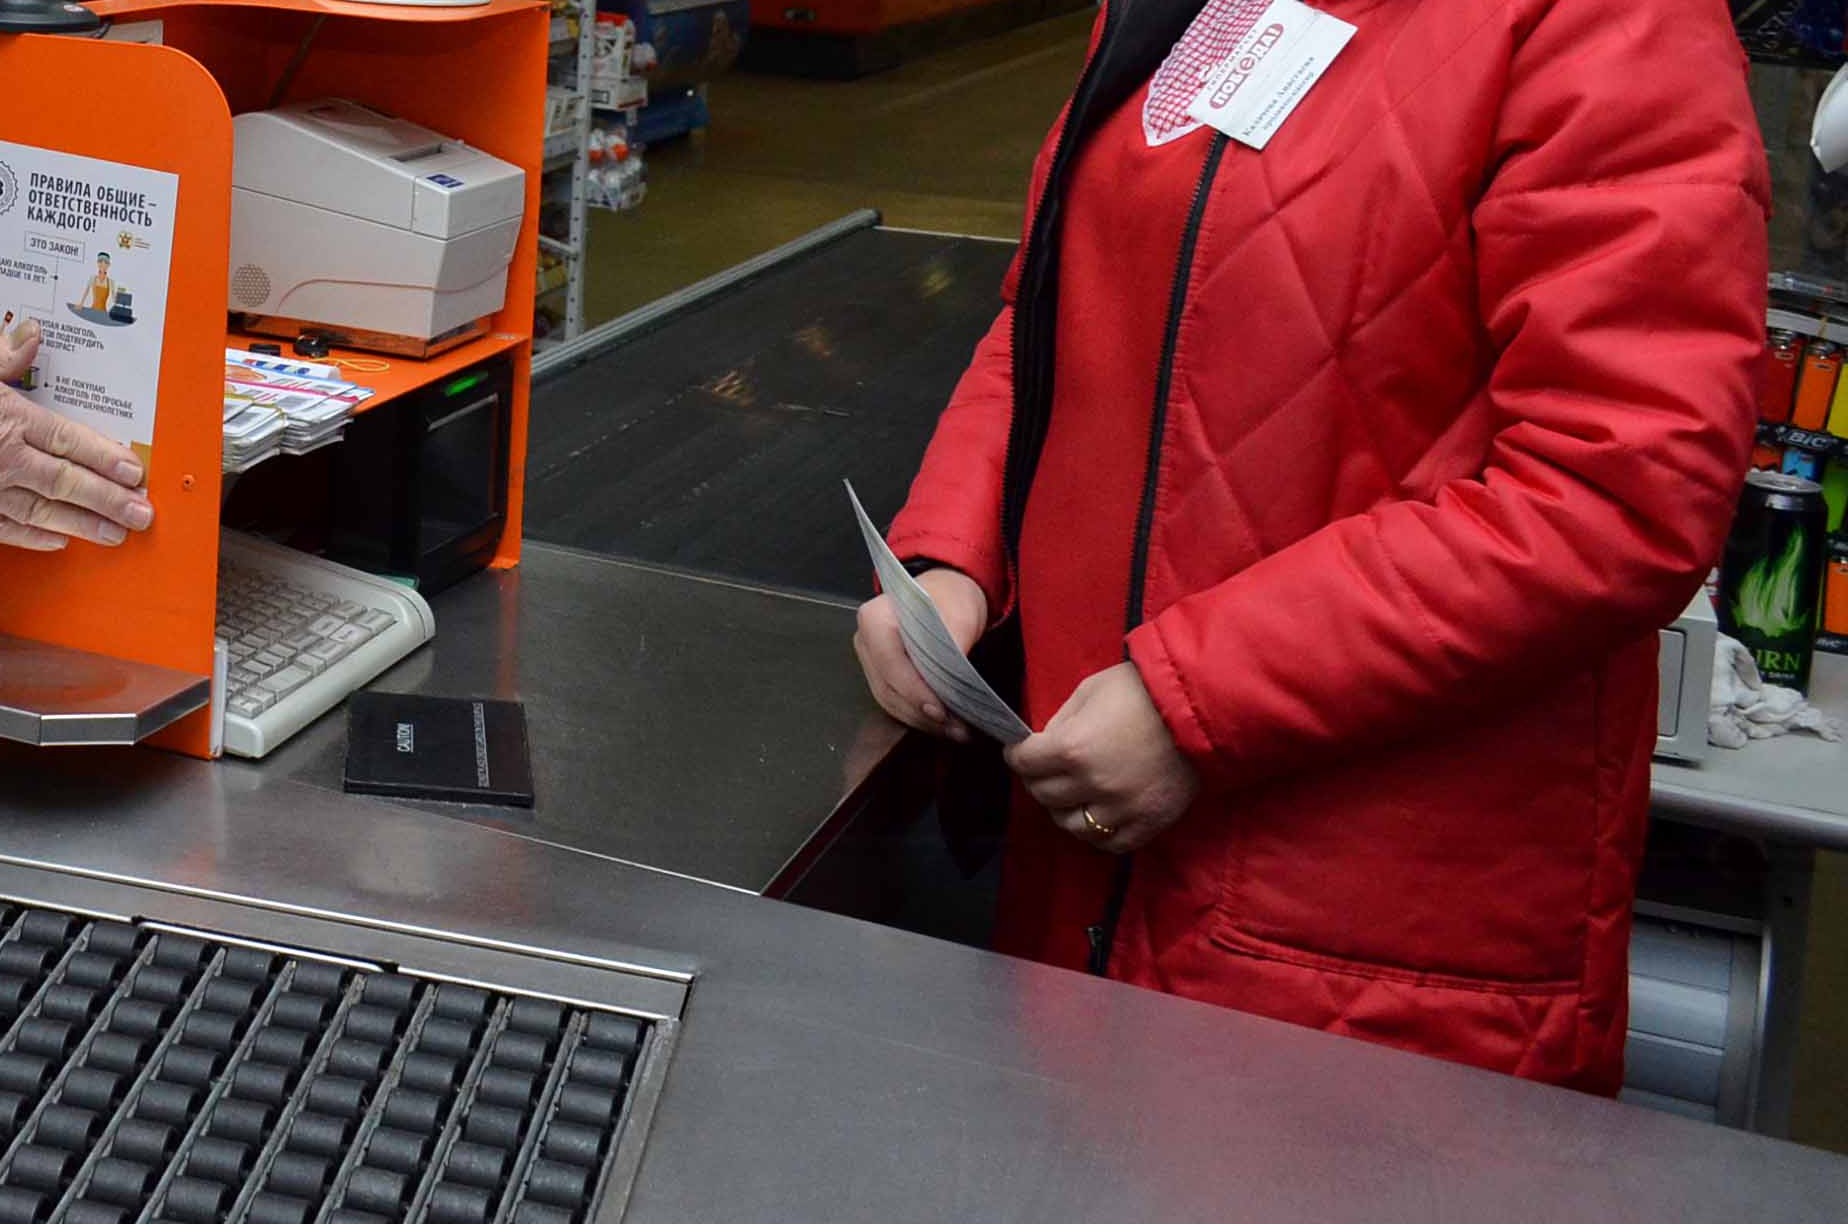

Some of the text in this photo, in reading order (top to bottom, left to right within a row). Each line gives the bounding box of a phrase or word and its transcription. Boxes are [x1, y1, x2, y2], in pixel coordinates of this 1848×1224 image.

[30, 173, 91, 198] ПРАВИЛА
[97, 186, 145, 209] ОБЩИЕ
[27, 206, 96, 233] КАЖДОГО!
[28, 190, 152, 227] ОТВЕТСТВЕННОСТЬ
[30, 237, 79, 256] ЭТО ЗАКОН!
